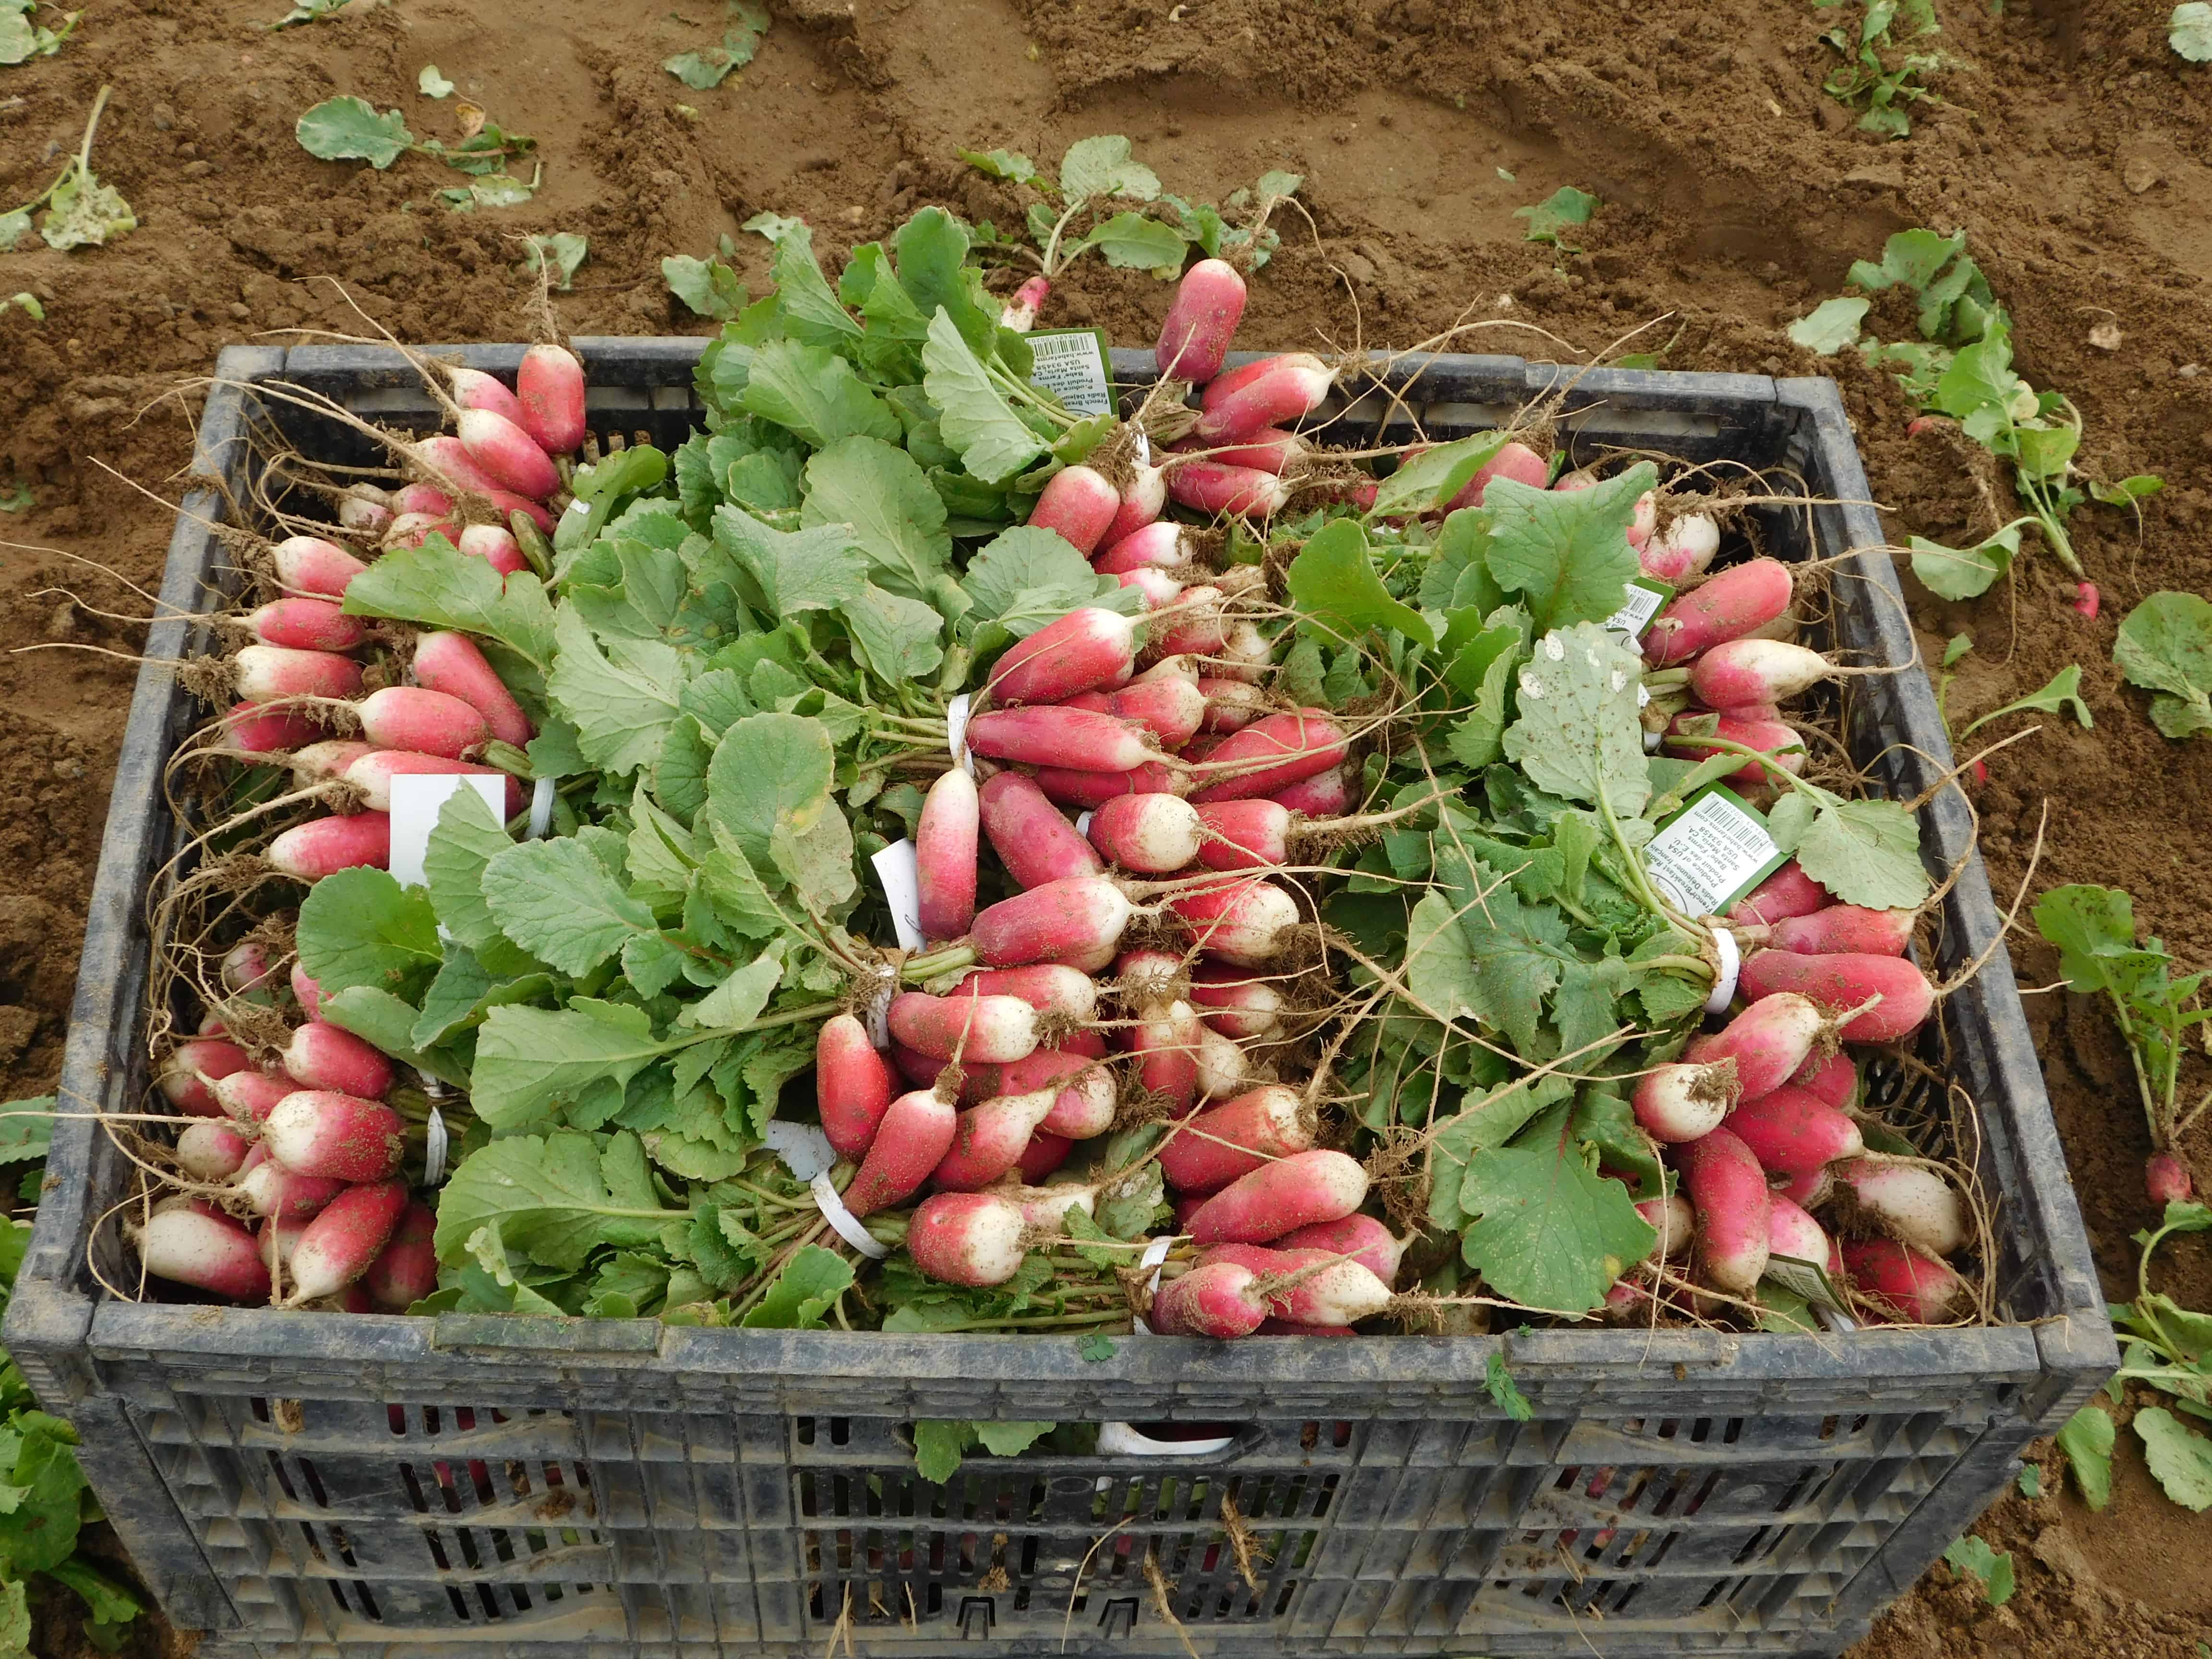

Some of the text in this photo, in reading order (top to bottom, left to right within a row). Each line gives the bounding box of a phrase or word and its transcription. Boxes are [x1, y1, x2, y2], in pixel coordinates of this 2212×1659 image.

[1686, 825, 1740, 871] Santa Maria, CA,
[1687, 835, 1708, 854] Farms
[1694, 810, 1759, 864] www.babefarms.com
[1698, 826, 1738, 859] USA 93458
[1649, 842, 1673, 865] français
[1689, 850, 1702, 862] des
[1667, 843, 1719, 889] Produce of USA
[1701, 860, 1726, 884] Produit
[1662, 864, 1693, 893] Breakfast
[1691, 891, 1713, 913] French
[1700, 888, 1719, 906] Radis
